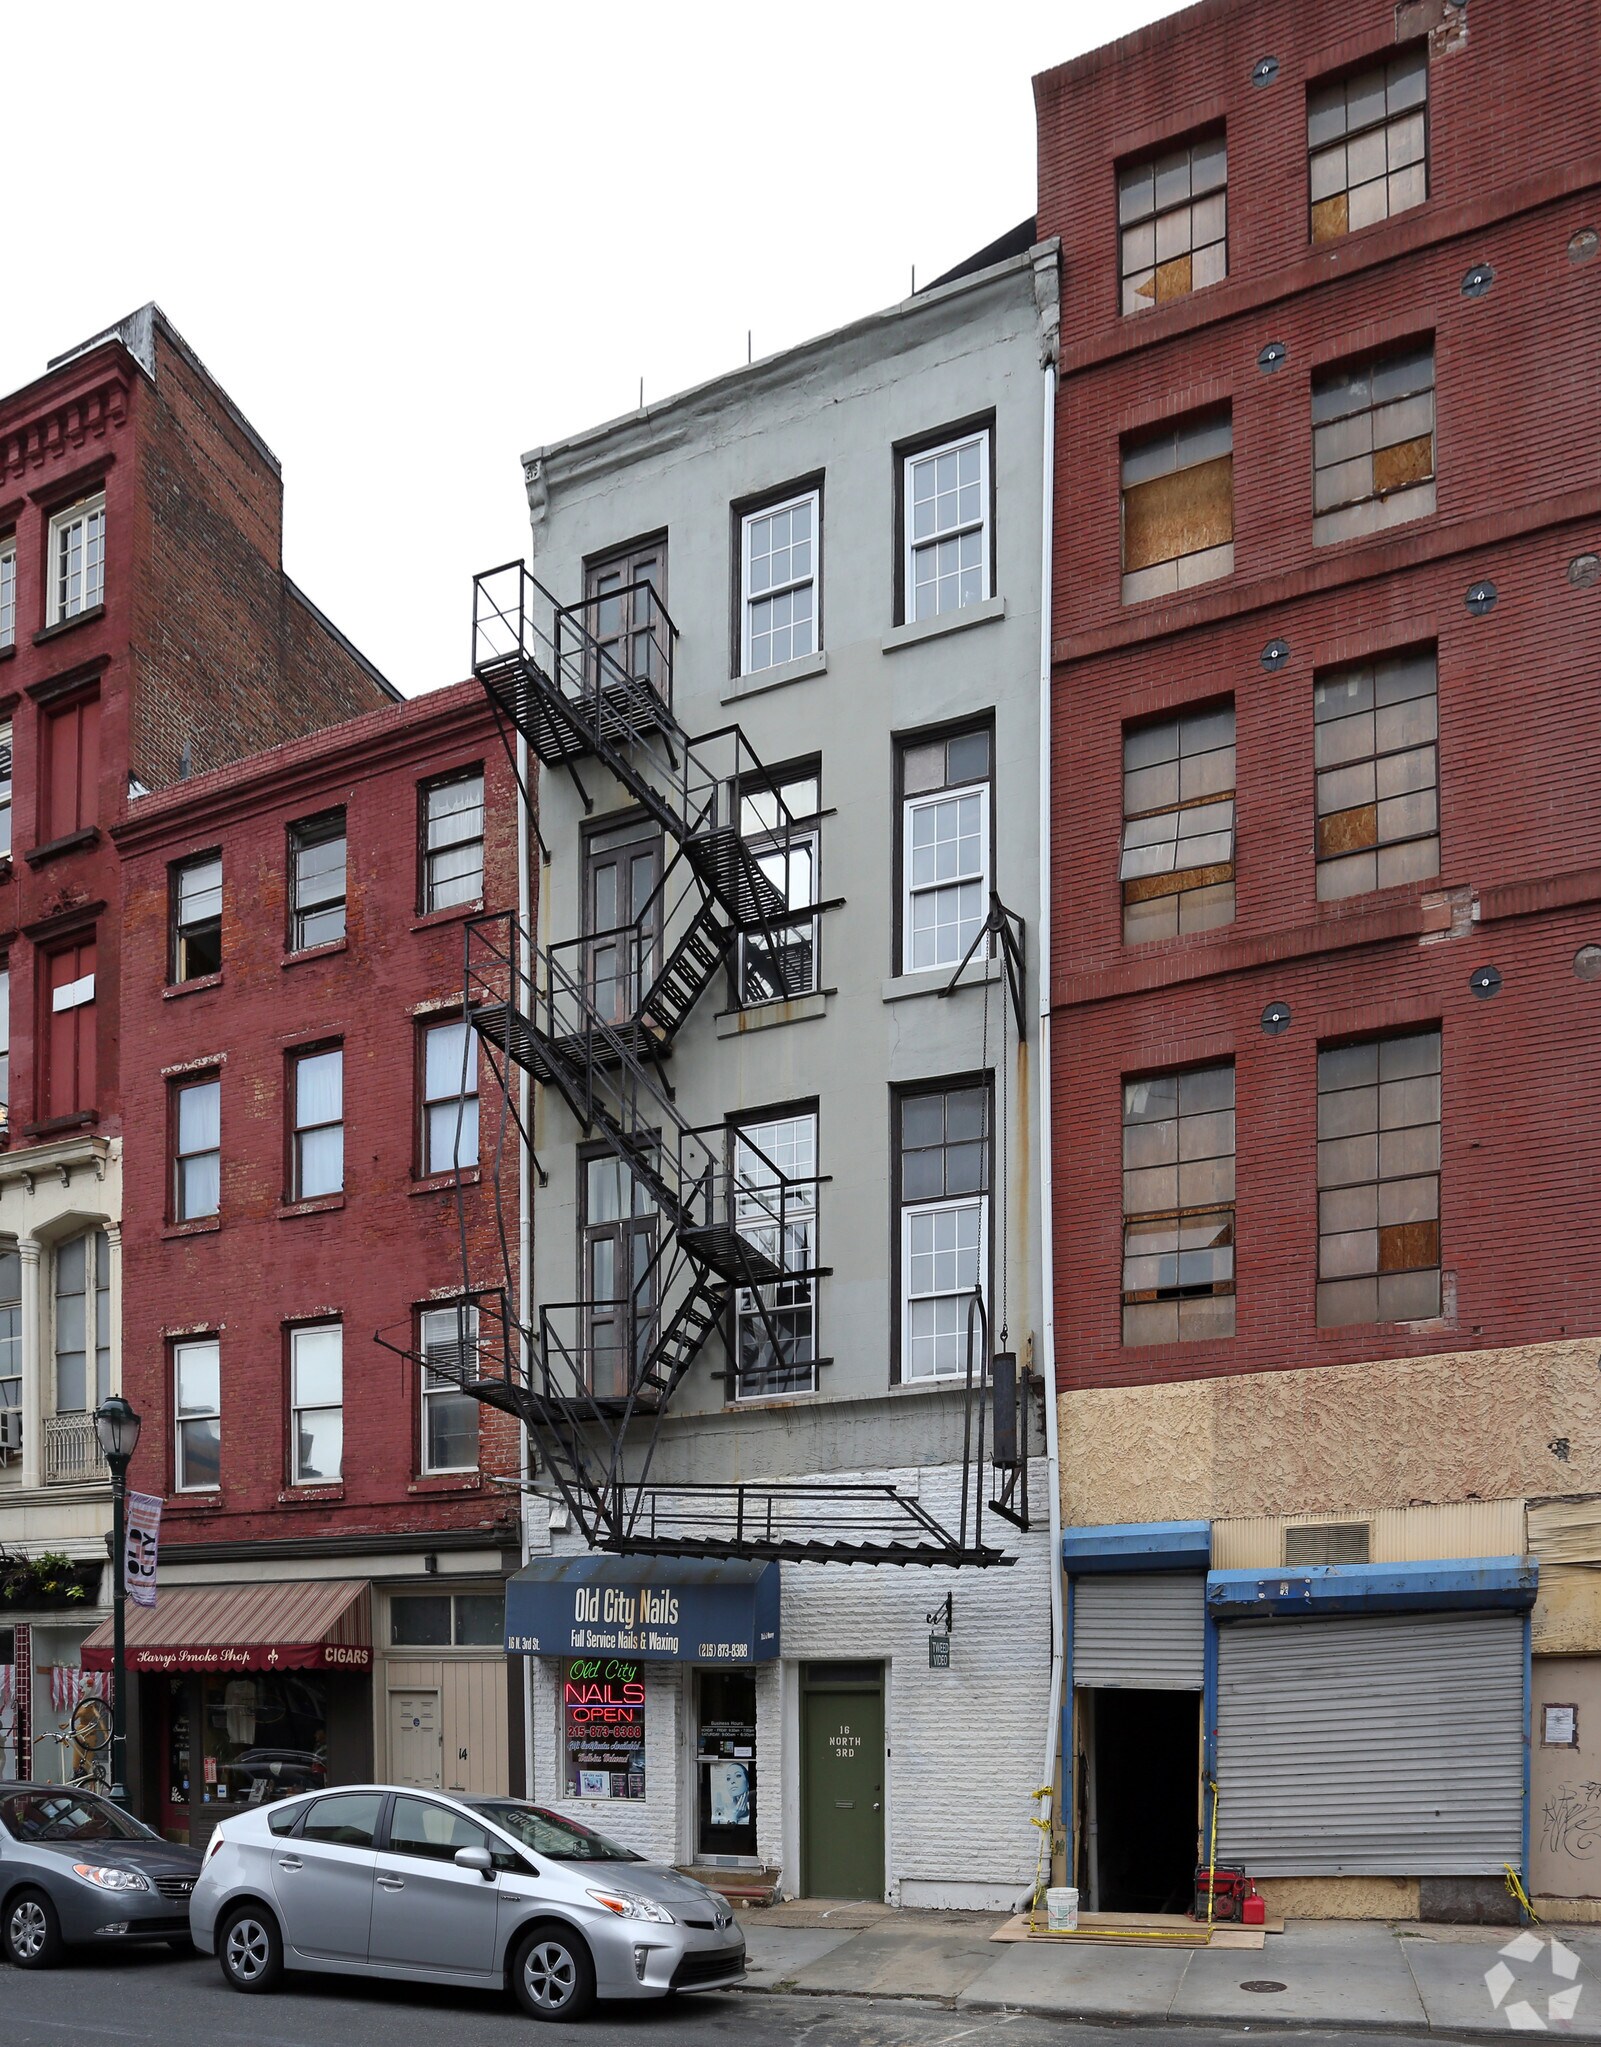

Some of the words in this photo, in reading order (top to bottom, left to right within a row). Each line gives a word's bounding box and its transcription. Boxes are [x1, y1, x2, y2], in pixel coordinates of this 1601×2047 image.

[128, 1529, 142, 1574] OLD
[140, 1532, 156, 1577] CITY
[575, 1588, 599, 1622] Old
[603, 1588, 635, 1629] City
[639, 1589, 679, 1625] Nails
[508, 1636, 515, 1649] 16
[522, 1637, 532, 1650] 3rd
[571, 1630, 585, 1648] Full
[586, 1631, 616, 1649] Service
[617, 1632, 638, 1650] Nails
[640, 1633, 647, 1650] &
[649, 1632, 679, 1654] Waxing
[137, 1650, 177, 1668] Harrys
[178, 1649, 218, 1663] Smoke
[220, 1648, 251, 1665] Shop
[325, 1647, 369, 1664] CIGARS
[698, 1643, 717, 1658] (215)
[717, 1643, 748, 1658] 873-8388
[933, 1654, 948, 1666] VIDEO
[569, 1659, 602, 1680] Old
[605, 1659, 637, 1683] City
[565, 1683, 645, 1704] NAILS
[573, 1707, 633, 1722] OPEN
[568, 1726, 642, 1738] 215-873-8388
[839, 1725, 850, 1735] 16
[829, 1737, 861, 1746] NORTH
[458, 1748, 468, 1760] 14
[835, 1748, 855, 1758] 3RD
